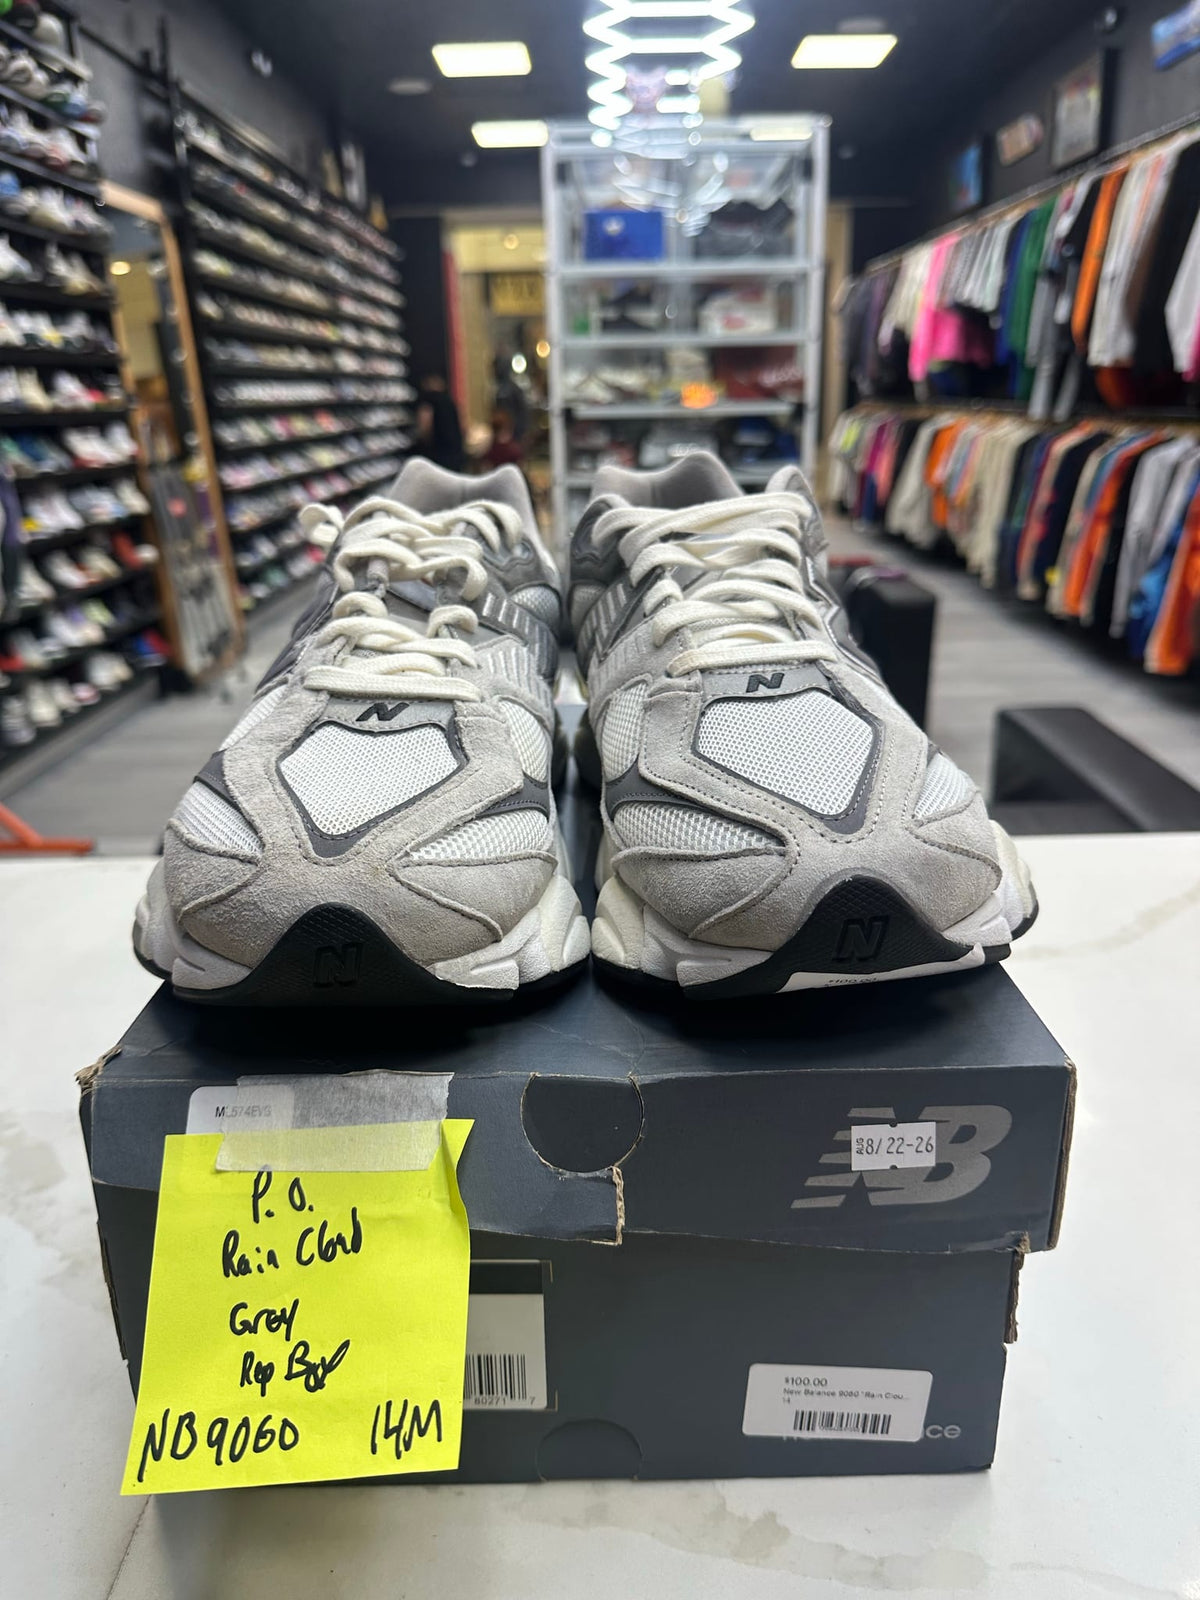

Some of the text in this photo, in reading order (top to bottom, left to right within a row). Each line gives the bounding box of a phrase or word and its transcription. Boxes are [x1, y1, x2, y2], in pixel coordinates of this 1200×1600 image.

[747, 673, 785, 693] N
[355, 702, 410, 722] N
[835, 916, 889, 962] N
[313, 943, 362, 987] N
[222, 1230, 279, 1278] Rain
[783, 1387, 801, 1395] New
[804, 1388, 836, 1397] Balance
[784, 1376, 828, 1387] $100.00
[371, 1399, 443, 1460] 14M
